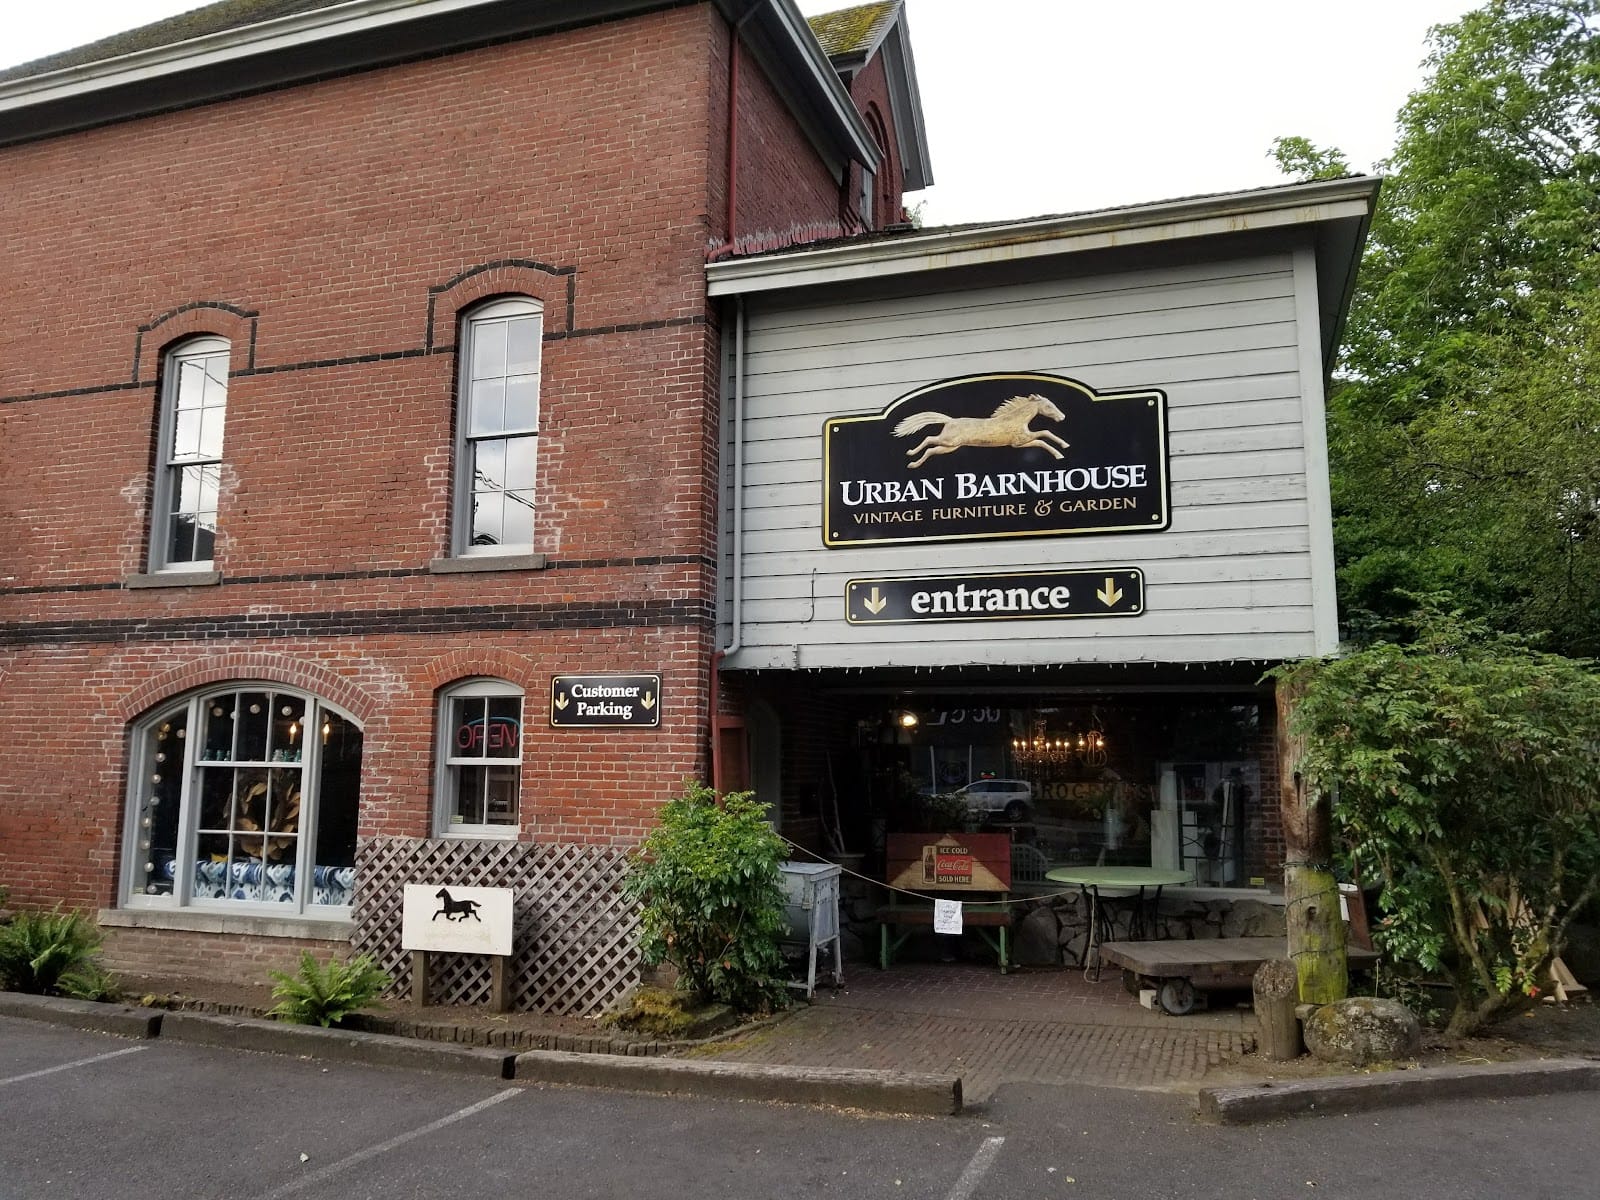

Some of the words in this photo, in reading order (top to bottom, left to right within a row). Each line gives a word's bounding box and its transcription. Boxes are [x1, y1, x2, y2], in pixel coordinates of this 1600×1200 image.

[840, 478, 945, 506] URBAN
[955, 464, 1148, 500] BARNHOUSE
[853, 509, 923, 525] VINTAGE
[932, 503, 1027, 520] FURNITURE
[1034, 500, 1052, 517] &
[1060, 497, 1137, 513] GARDEN
[911, 583, 1070, 614] entrance
[571, 684, 640, 698] Customer
[577, 701, 633, 720] Parking
[455, 723, 517, 749] OPEN
[952, 847, 968, 855] COLD
[939, 875, 954, 883] SOLD
[954, 875, 969, 883] HERE
